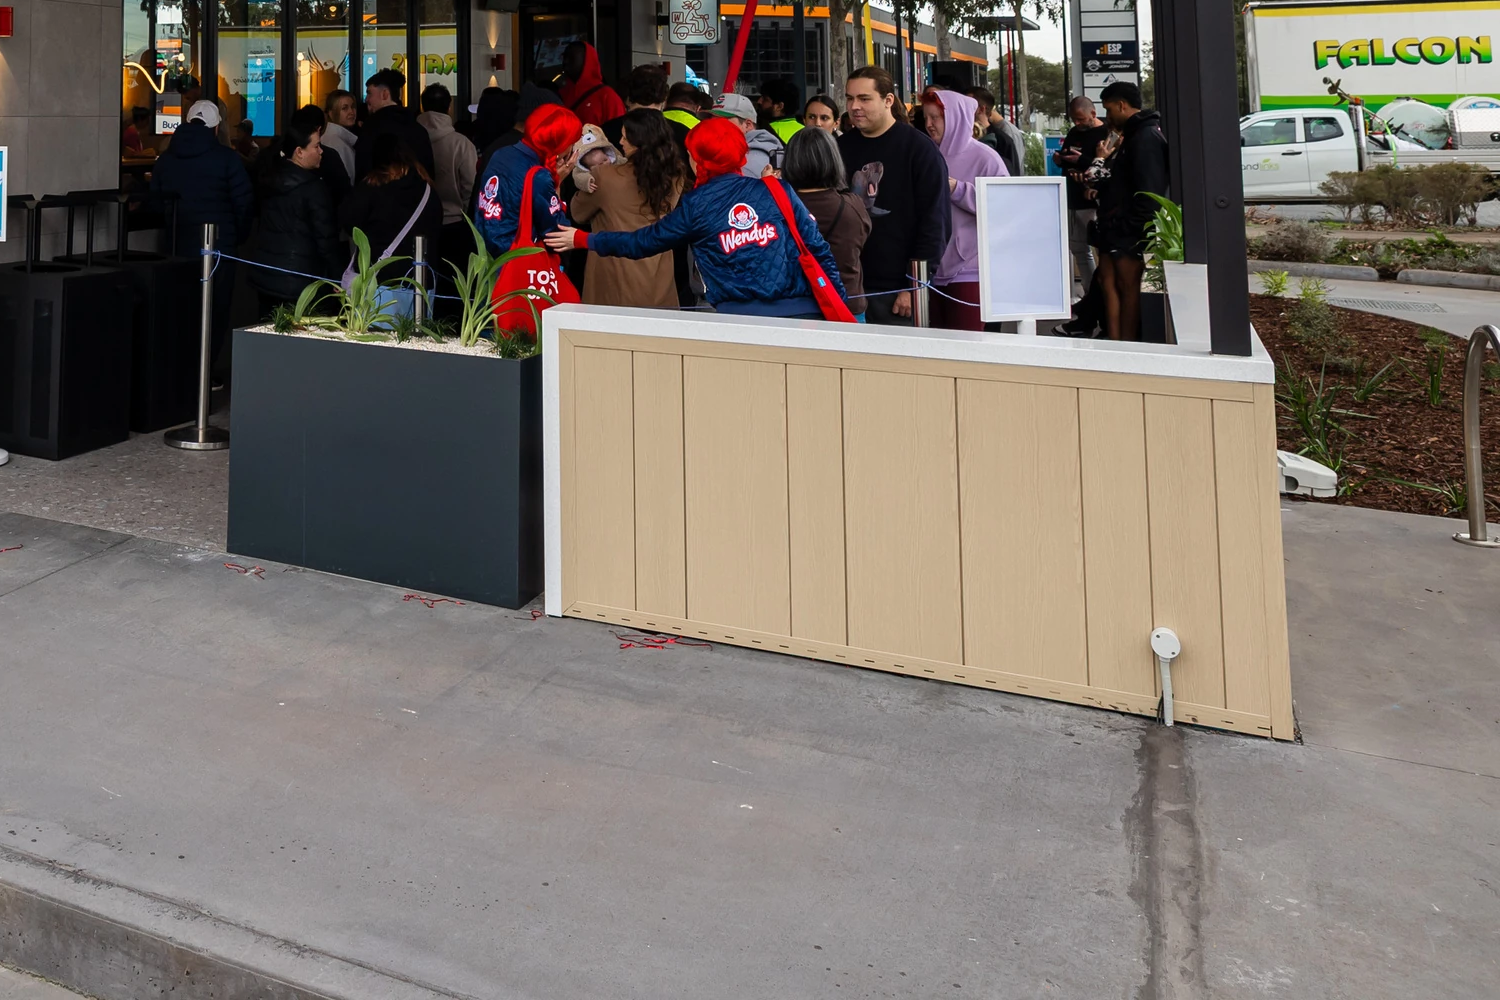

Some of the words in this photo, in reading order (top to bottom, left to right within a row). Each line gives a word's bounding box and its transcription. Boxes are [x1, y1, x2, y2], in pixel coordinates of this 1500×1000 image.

[1108, 43, 1122, 53] ESP
[1313, 35, 1493, 70] FALCON
[720, 223, 776, 253] Wendy's
